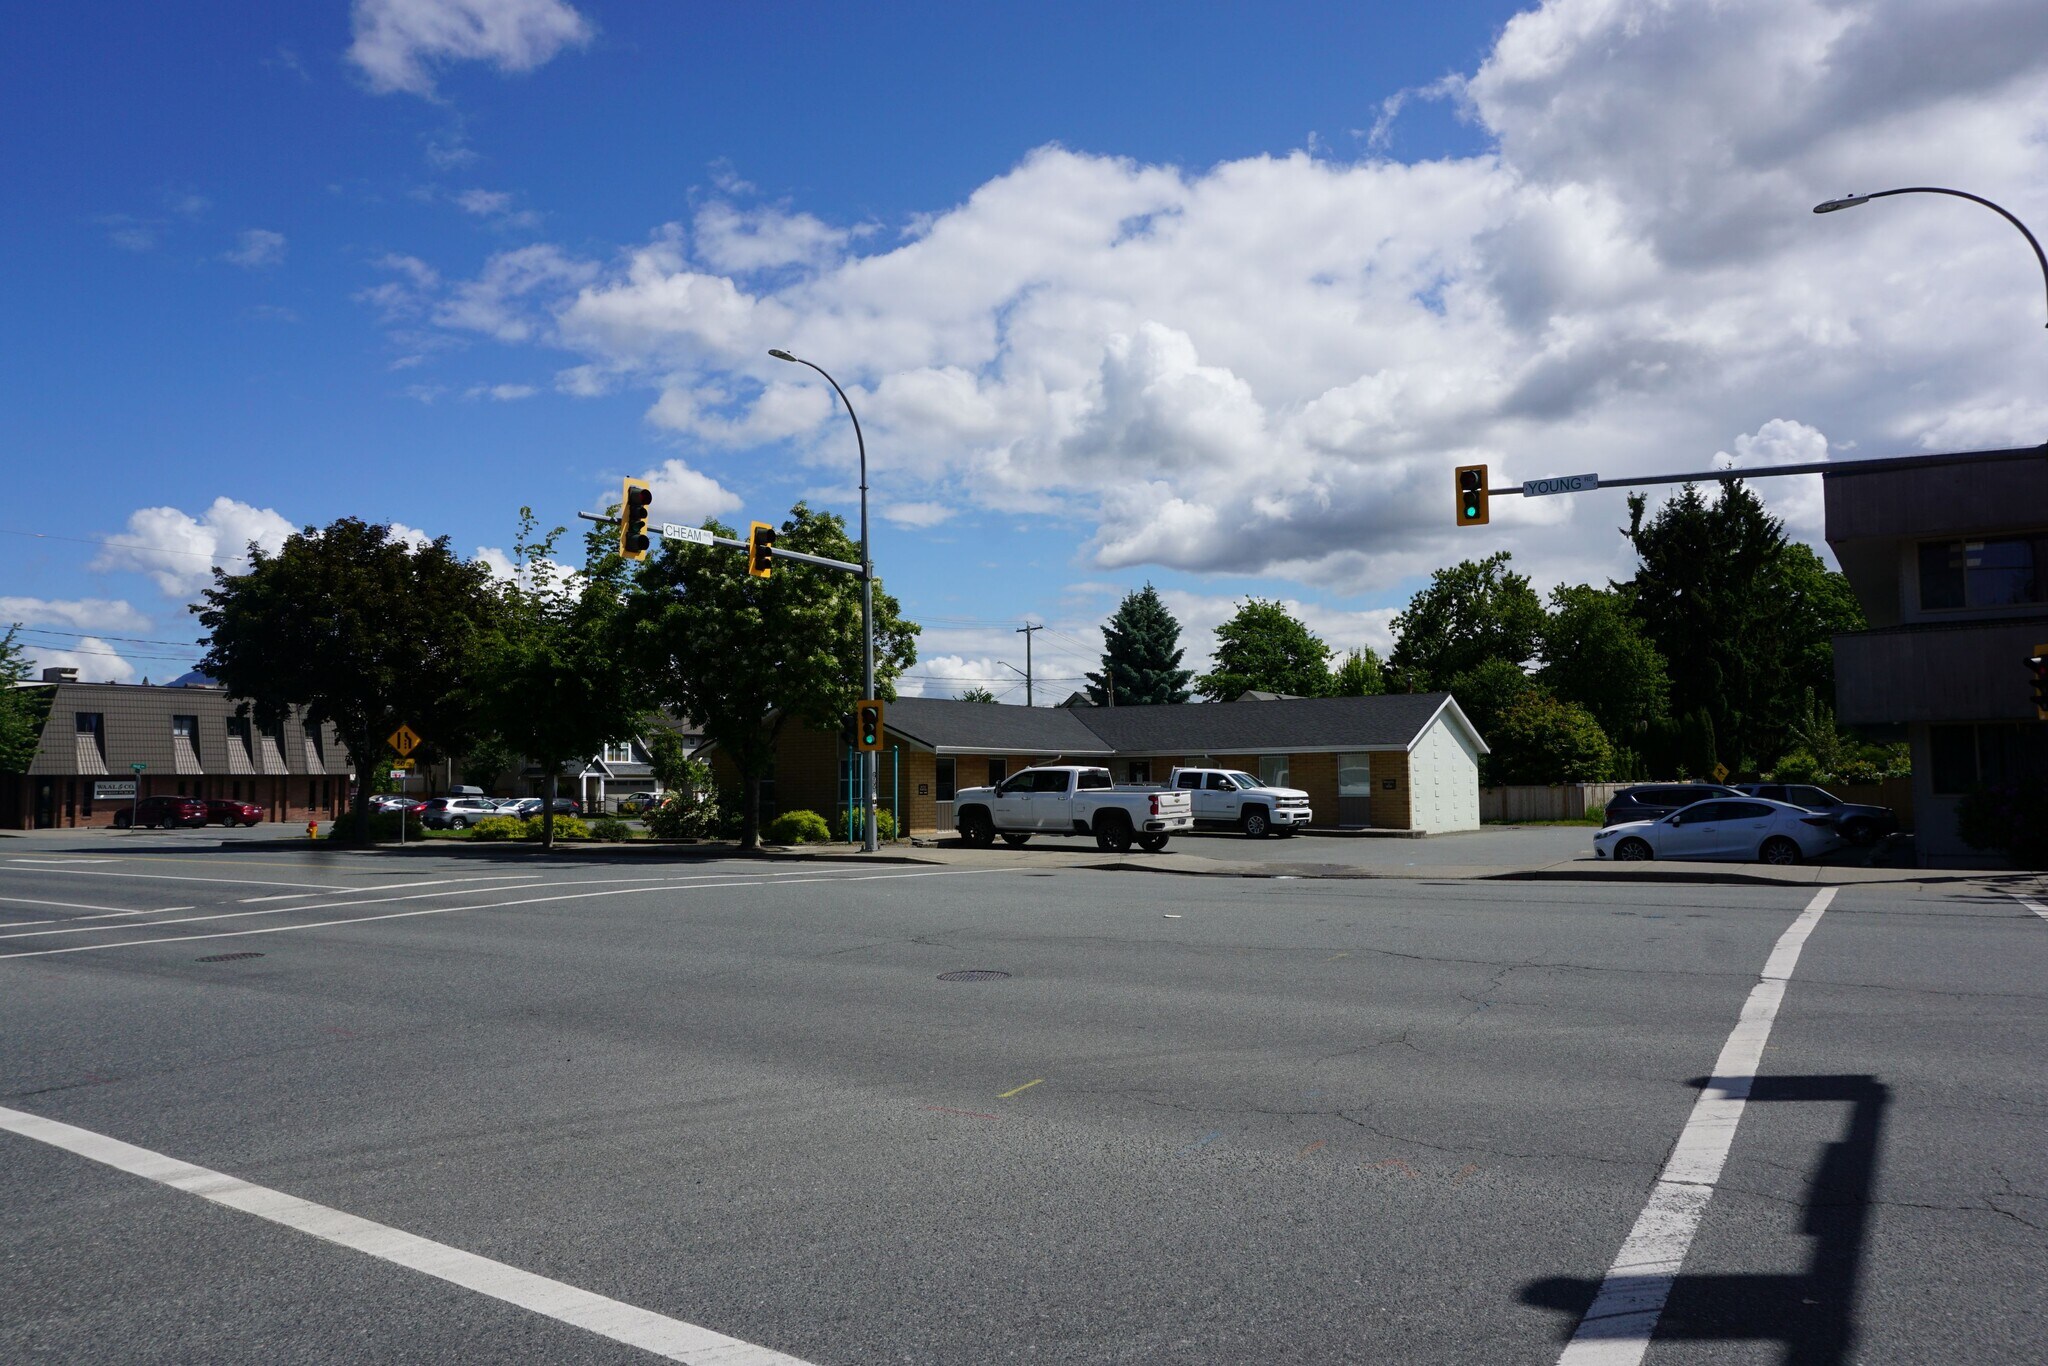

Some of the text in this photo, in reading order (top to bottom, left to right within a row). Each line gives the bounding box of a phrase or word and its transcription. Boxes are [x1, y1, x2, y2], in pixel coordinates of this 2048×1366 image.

[1528, 475, 1594, 494] YOUNG RD
[665, 525, 702, 542] CHEAM
